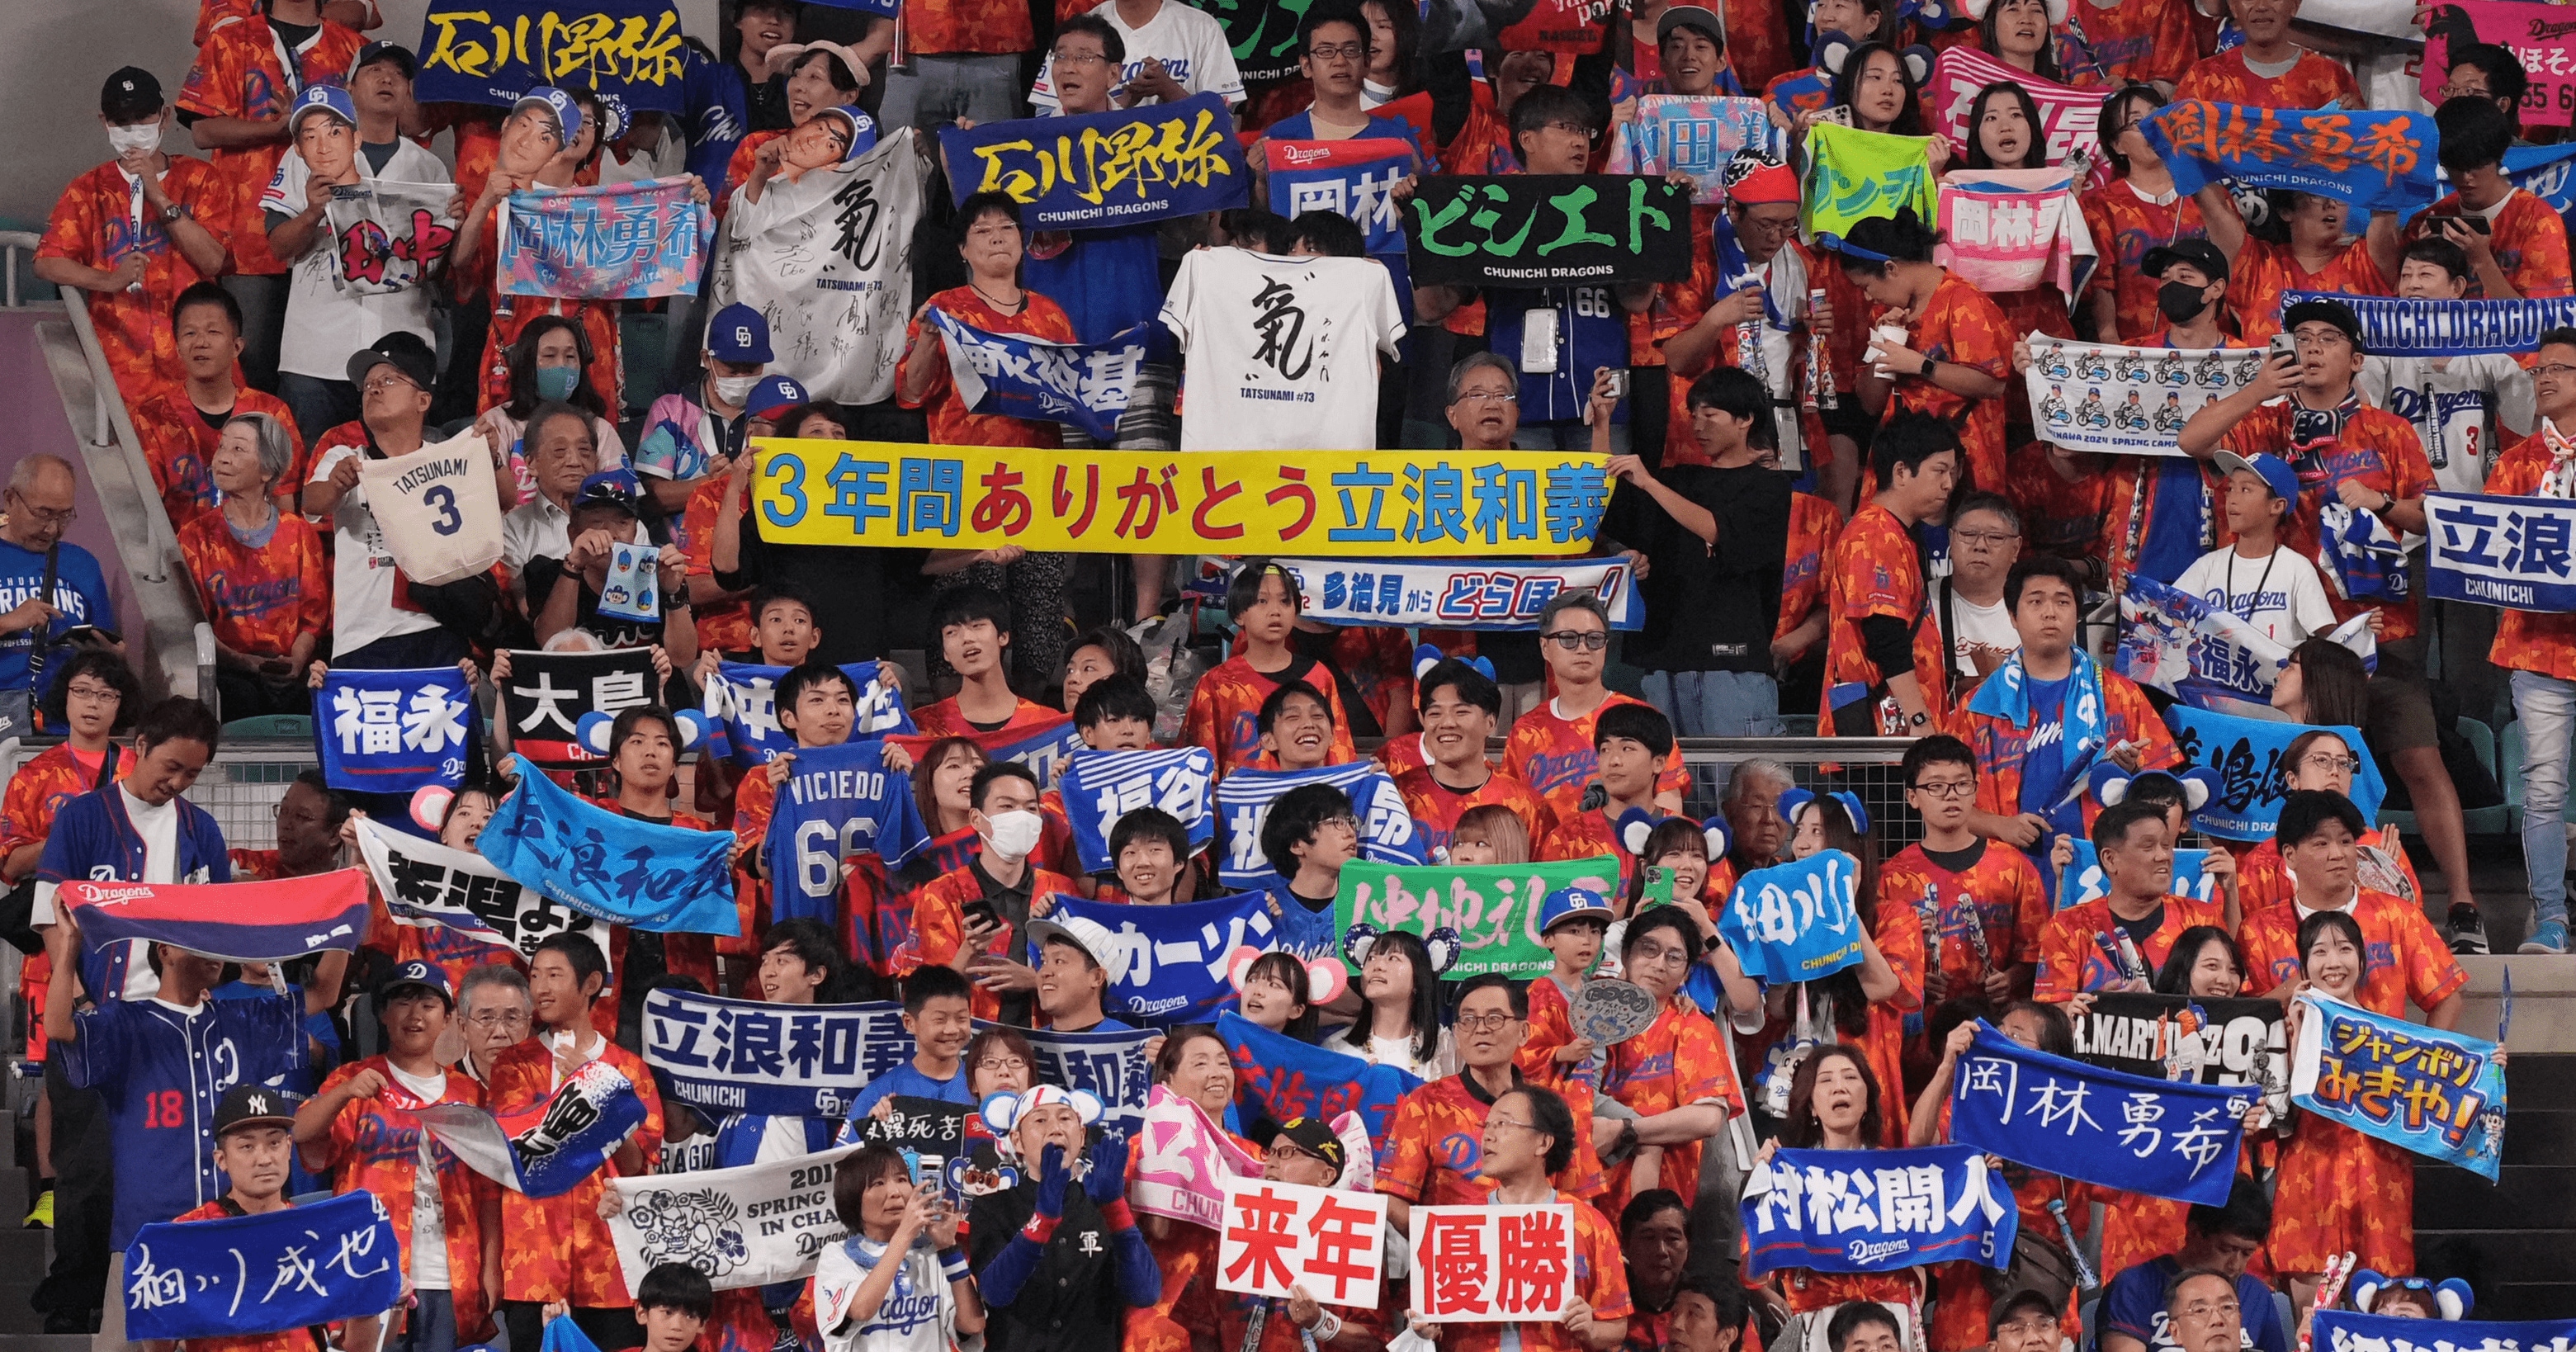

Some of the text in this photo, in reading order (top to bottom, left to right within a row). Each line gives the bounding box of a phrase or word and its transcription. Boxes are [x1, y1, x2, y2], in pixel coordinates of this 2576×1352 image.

[1283, 145, 1331, 165] Dragons
[2291, 175, 2353, 194] DRAGONS
[1037, 199, 1170, 224] CHUNICHI DRAGONS
[1411, 177, 1680, 258] ビシエド
[508, 201, 698, 269] 岡林勇希
[815, 277, 866, 293] TATSUNAMI
[1483, 264, 1614, 279] CHUNICHI DRAGONS
[1576, 286, 1611, 319] 66
[1240, 387, 1316, 404] TATSUNAMI #73
[2084, 434, 2109, 445] 2024
[2112, 437, 2149, 447] SPRING
[2152, 439, 2178, 448] CAMP
[2465, 425, 2479, 456] 3
[392, 458, 468, 495] TATSUNAMI
[423, 485, 463, 537] 3
[762, 451, 1609, 545] 3年間ありがとう立浪和義
[2465, 577, 2534, 605] CHUNICHI
[2200, 633, 2264, 694] 福永
[333, 683, 470, 756] 福永
[789, 770, 886, 805] VICIEDO
[2196, 813, 2248, 832] CHUNICHI
[78, 884, 155, 908] Dragons
[407, 962, 428, 981] D
[1491, 961, 1556, 974] DRAGONS
[1128, 995, 1189, 1018] Dragons
[2337, 1023, 2477, 1089] ジャンボリ
[248, 1094, 268, 1116] NY
[674, 1078, 746, 1109] CHUNICHI
[2315, 1054, 2482, 1140] みきや!
[145, 1090, 185, 1129] 18
[1959, 1056, 2229, 1182] 岡林勇希
[789, 1161, 837, 1192] 201
[747, 1190, 826, 1220] SPRING
[759, 1220, 784, 1237] IN
[1224, 1186, 1378, 1300] 来年
[1079, 1231, 1104, 1259] 軍
[1849, 1238, 1911, 1265] Dragons
[1981, 1230, 1996, 1260] 5
[130, 1230, 390, 1318] 細川成也
[1416, 1210, 1569, 1316] 優勝
